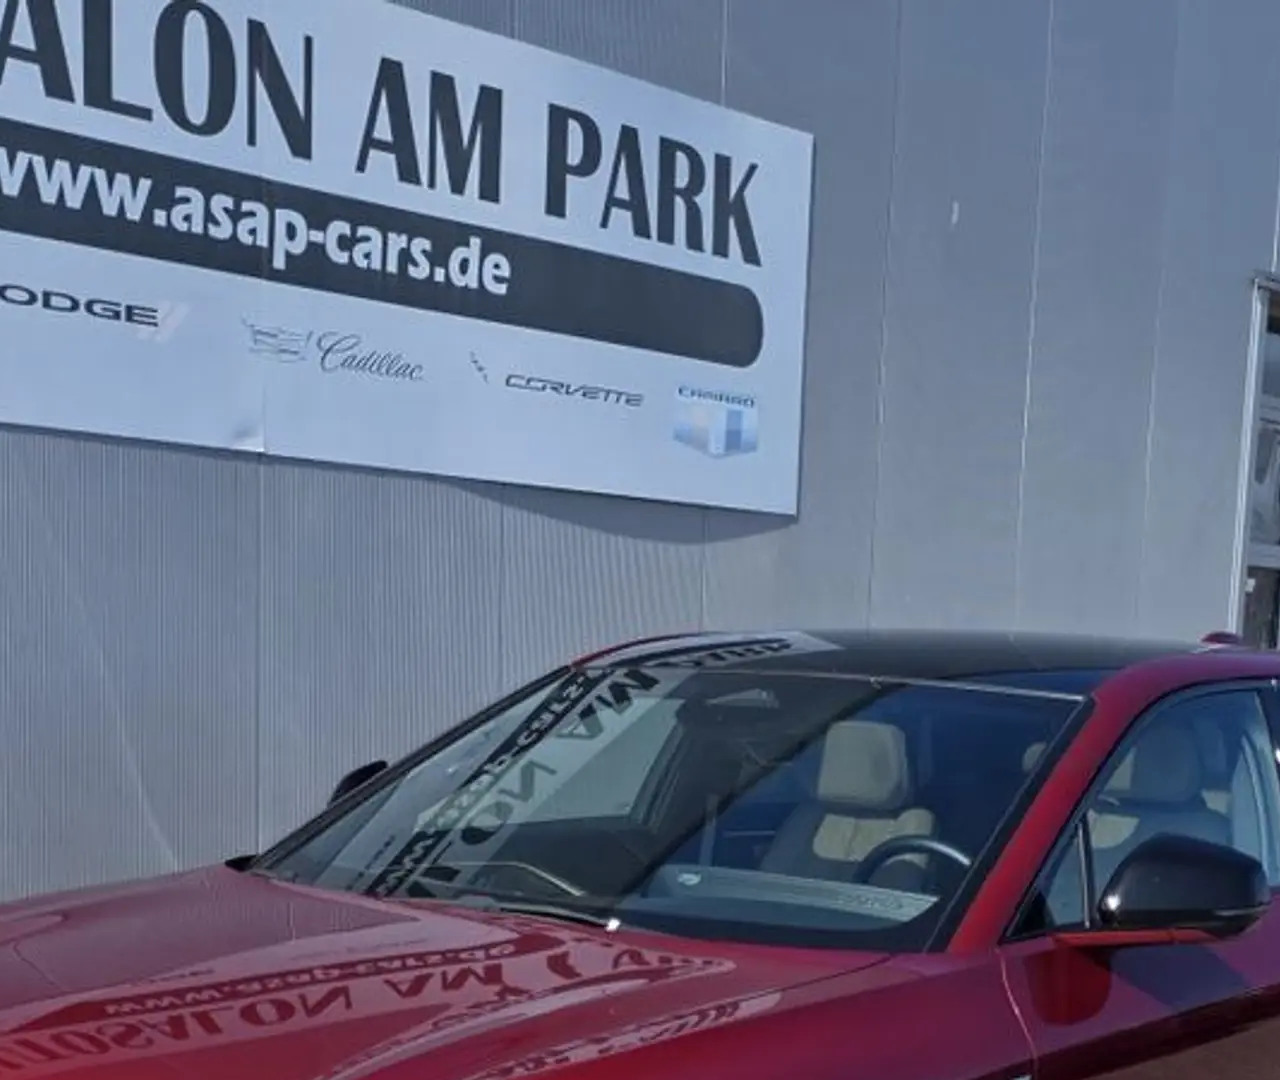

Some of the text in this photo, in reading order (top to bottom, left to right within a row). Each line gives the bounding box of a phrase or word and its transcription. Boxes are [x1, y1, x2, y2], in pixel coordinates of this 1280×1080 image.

[355, 56, 503, 204] AM
[544, 103, 762, 267] PARK
[316, 331, 426, 382] Cadillac
[505, 374, 644, 407] CORVETTE
